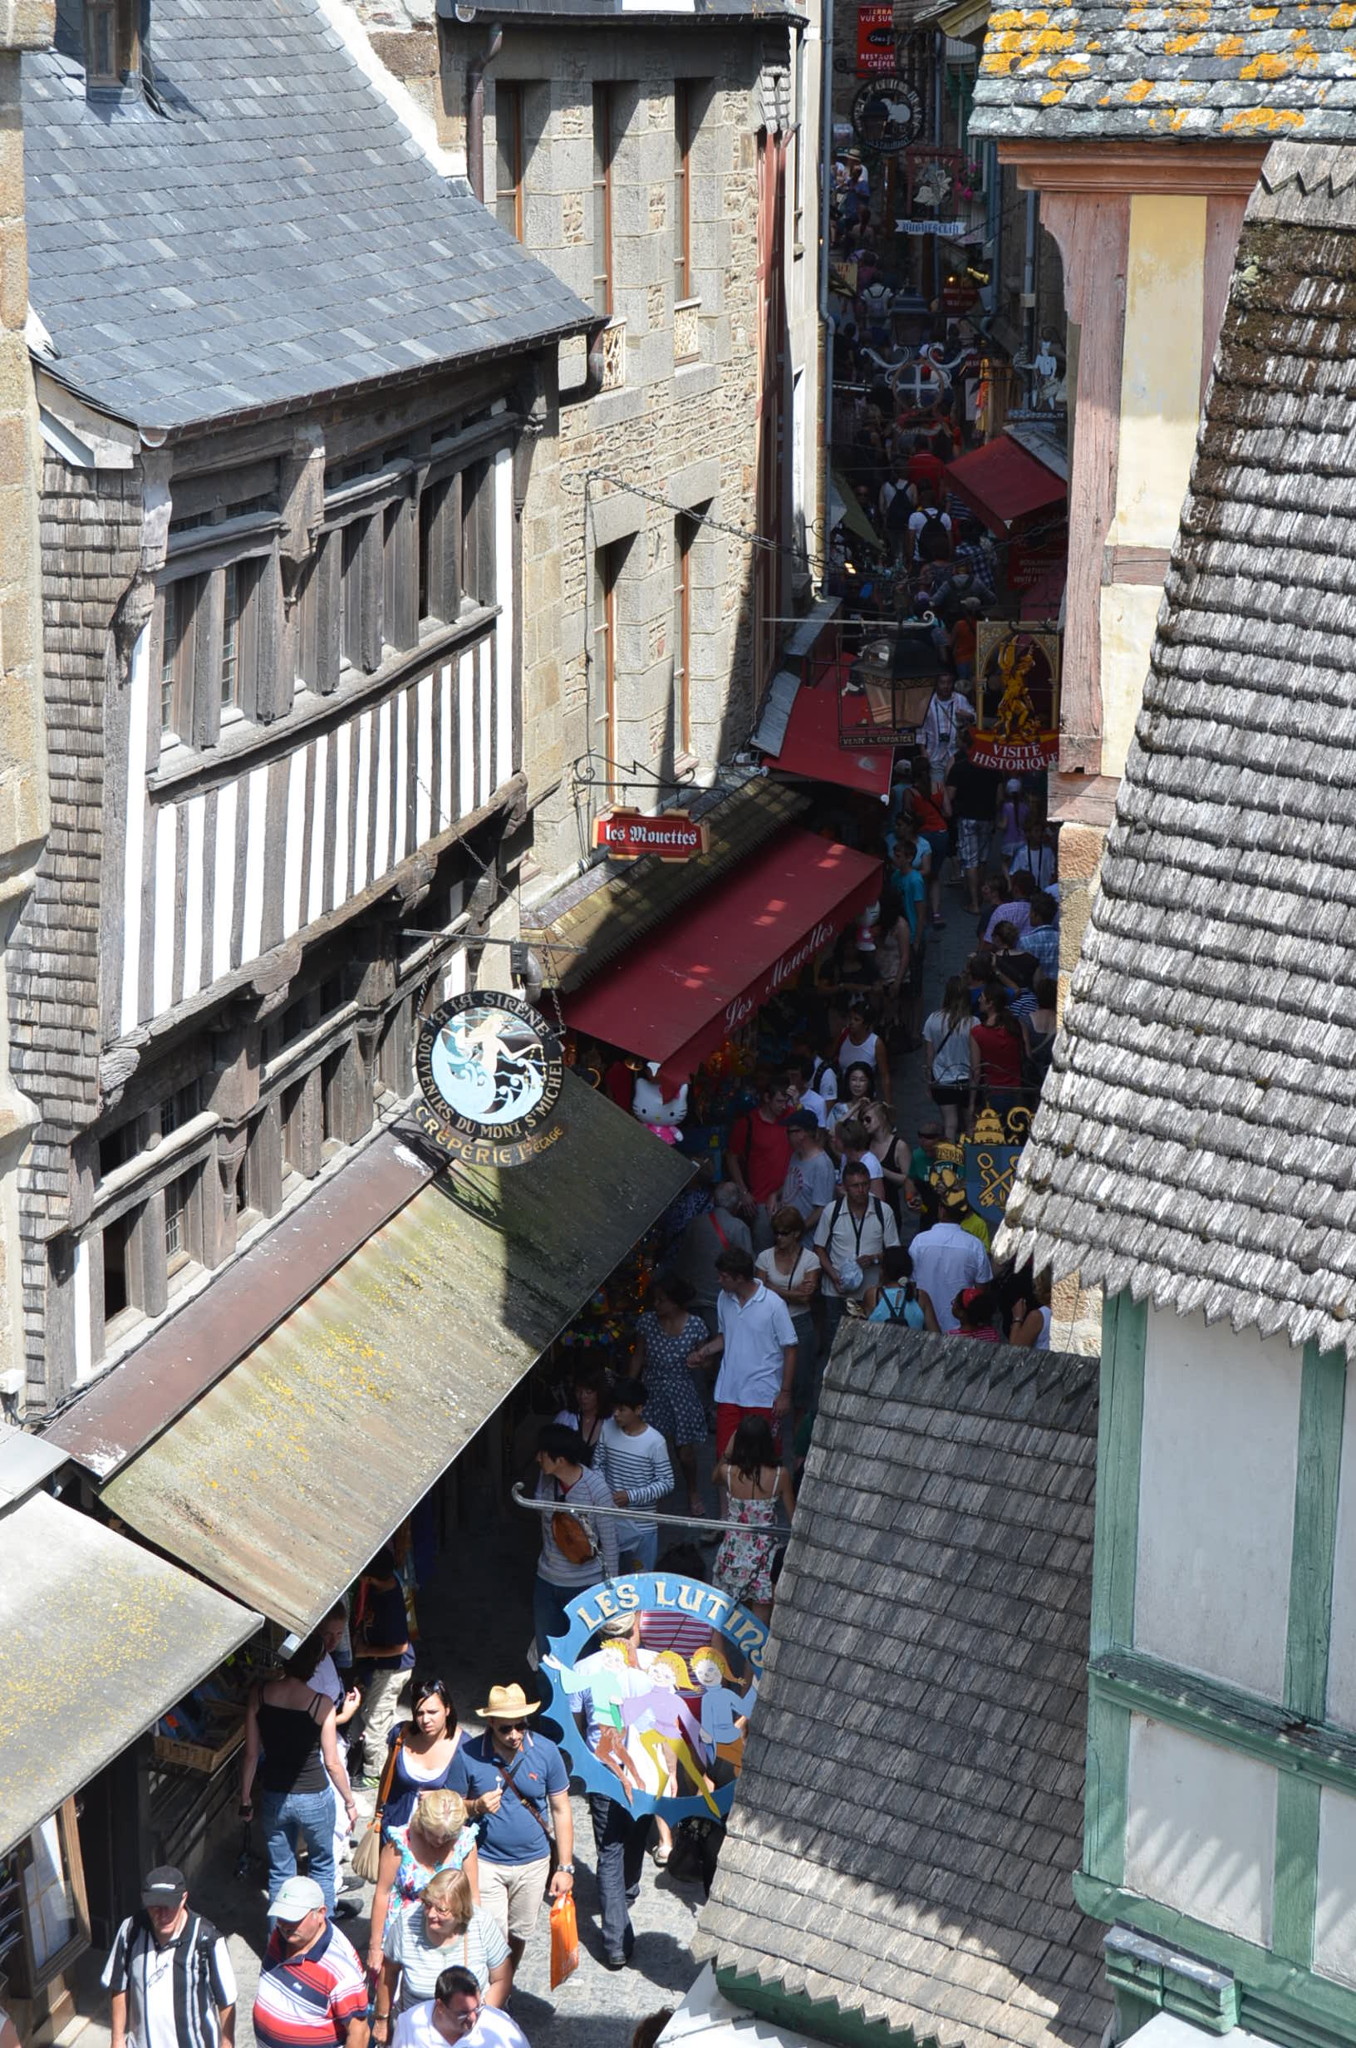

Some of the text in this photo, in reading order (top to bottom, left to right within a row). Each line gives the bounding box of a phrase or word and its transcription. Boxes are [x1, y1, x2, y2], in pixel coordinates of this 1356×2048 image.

[972, 751, 1058, 771] HISTORIQUE
[605, 824, 697, 846] les Mouettes
[450, 993, 475, 1012] LA
[723, 921, 836, 1034] Les Mouettes
[417, 1032, 455, 1120] SOUVENIRS
[455, 1116, 477, 1134] DU
[480, 1121, 522, 1138] MONT
[536, 1056, 563, 1117] MICHEL
[576, 1580, 769, 1667] LES LUTINS
